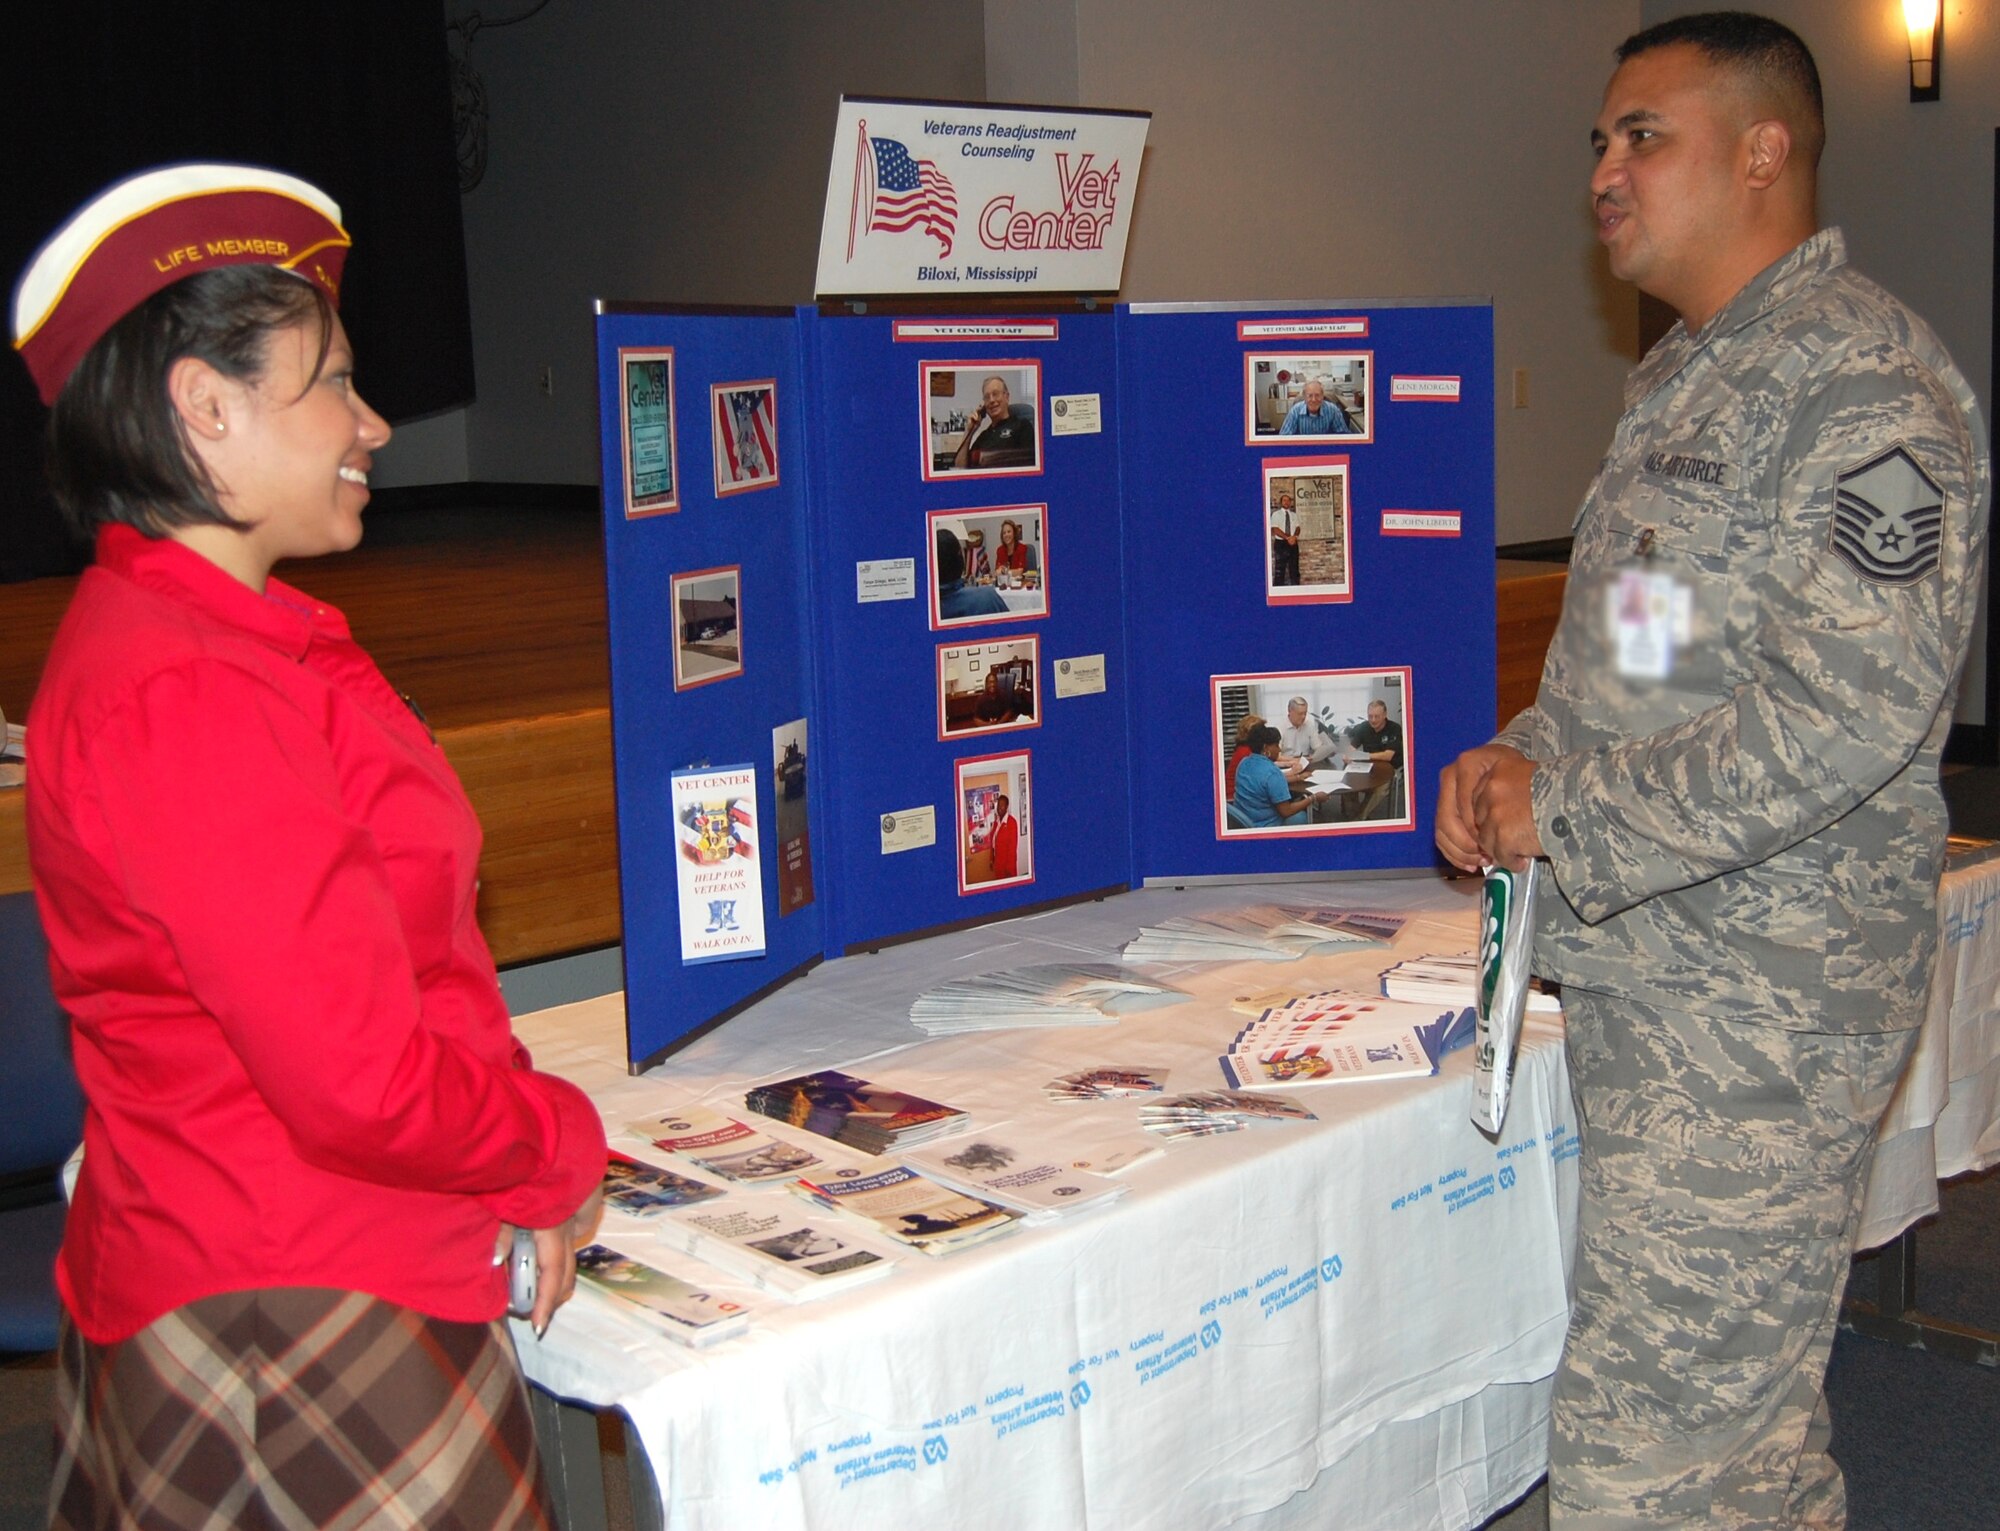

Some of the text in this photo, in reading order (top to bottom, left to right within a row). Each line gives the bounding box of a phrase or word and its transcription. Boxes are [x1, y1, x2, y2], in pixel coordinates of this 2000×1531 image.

[923, 120, 1077, 141] Veterans Readjustment
[961, 142, 1035, 162] Counseling
[1055, 152, 1121, 210] Vet
[978, 195, 1113, 252] Center
[154, 239, 289, 273] LIFE MEMBER
[917, 266, 1038, 283] Biloxi, Mississippi
[632, 383, 665, 408] Center
[1420, 383, 1457, 391] MORGAN
[1678, 457, 1728, 485] FORCE
[1297, 487, 1331, 499] Center
[1313, 479, 1331, 490] Vet
[678, 775, 751, 791] VET CENTER
[694, 869, 745, 883] HELP FOR
[694, 881, 748, 895] VETERANS
[693, 938, 721, 950] WALK
[723, 936, 738, 946] ON
[1496, 1148, 1511, 1160] Sale
[1512, 1143, 1524, 1154] For
[824, 1182, 847, 1191] DAV
[881, 1173, 910, 1186] 2009
[1391, 1168, 1467, 1211] Property Not For Sale
[1444, 1173, 1494, 1202] Veterans Affairs
[1448, 1185, 1494, 1215] Department of
[1255, 1265, 1288, 1289] Property
[1260, 1266, 1318, 1307] Veterans Affairs
[1218, 1294, 1232, 1305] For
[1233, 1287, 1249, 1301] Not
[1265, 1279, 1318, 1319] Department of
[1200, 1300, 1217, 1315] Sale
[1129, 1330, 1164, 1351] Property
[1089, 1354, 1103, 1366] For
[1135, 1332, 1197, 1372] Veterans Affairs
[1141, 1345, 1197, 1386] Department of
[985, 1384, 1024, 1406] Property
[961, 1404, 977, 1420] Not
[991, 1390, 1064, 1425] Veterans Affairs
[945, 1413, 960, 1425] For
[997, 1404, 1065, 1440] Department of
[834, 1445, 917, 1474] Veterans Affairs
[841, 1458, 917, 1490] Department of
